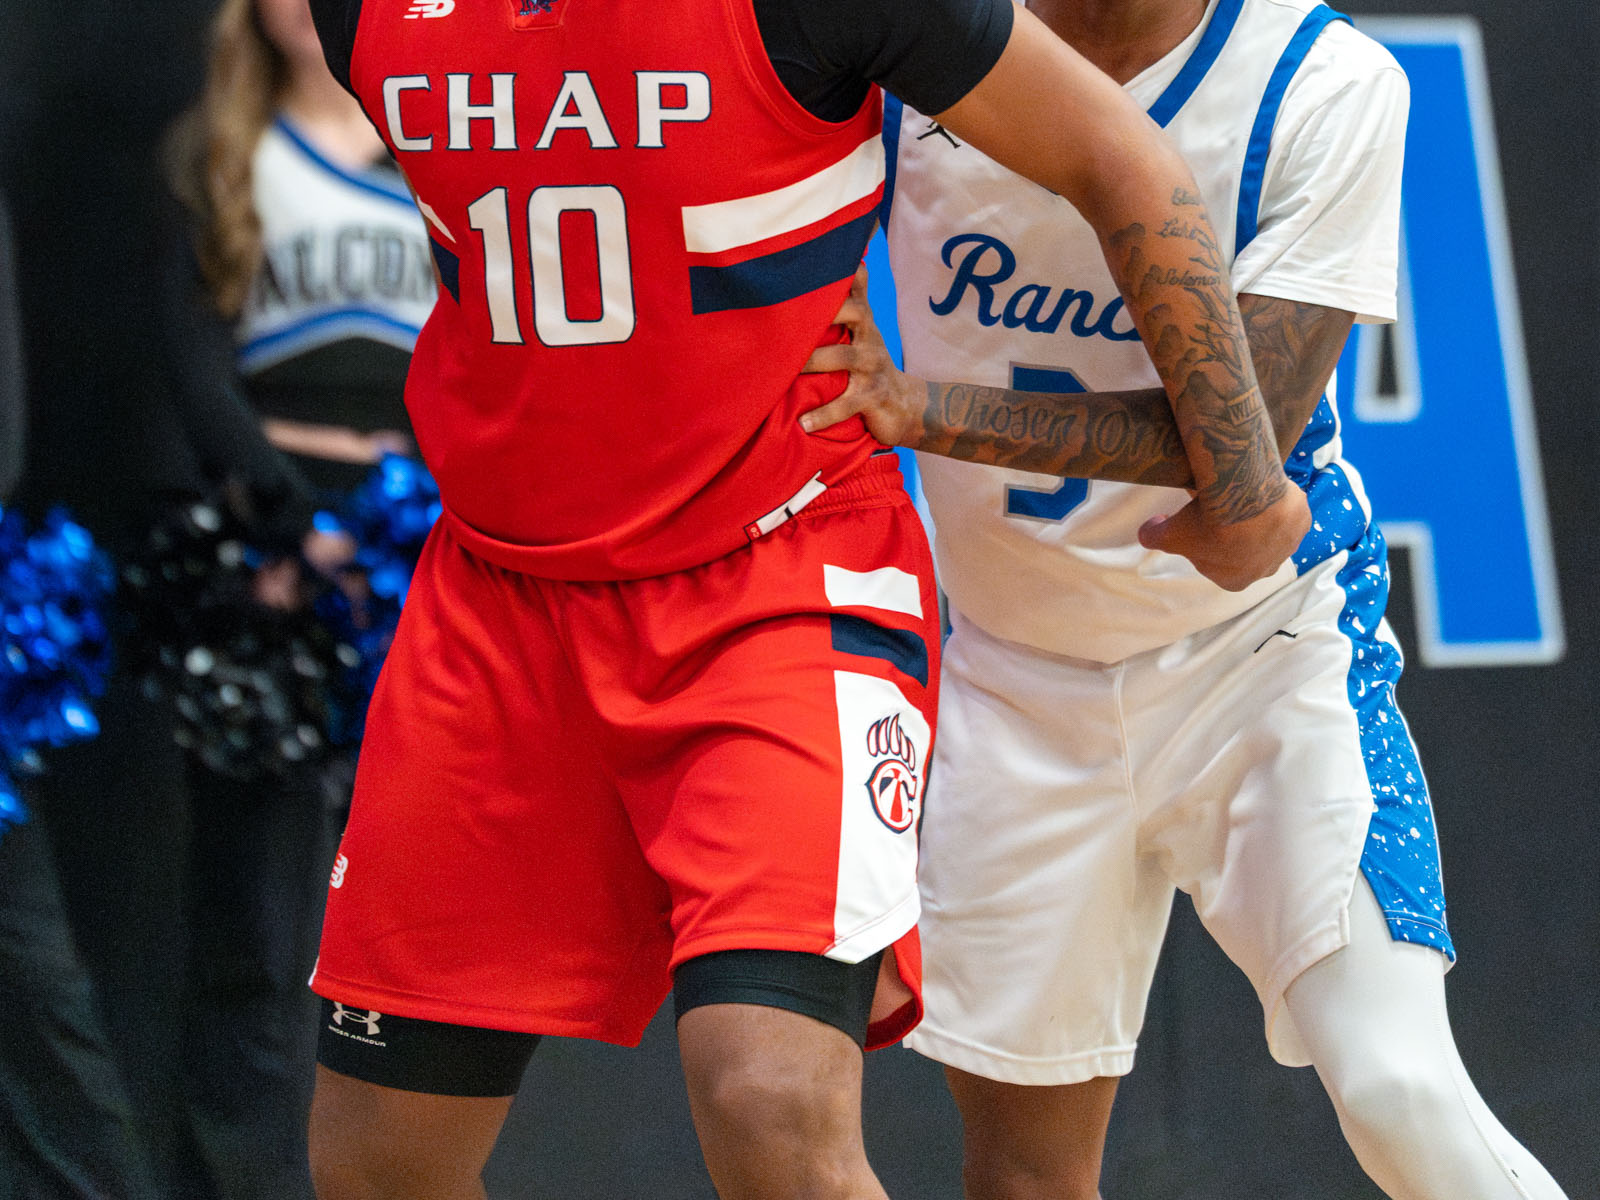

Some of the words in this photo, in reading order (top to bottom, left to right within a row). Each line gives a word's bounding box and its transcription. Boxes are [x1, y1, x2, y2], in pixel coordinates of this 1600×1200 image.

[382, 71, 711, 152] CHAP
[467, 185, 636, 347] 10
[943, 384, 1077, 449] Chosen
